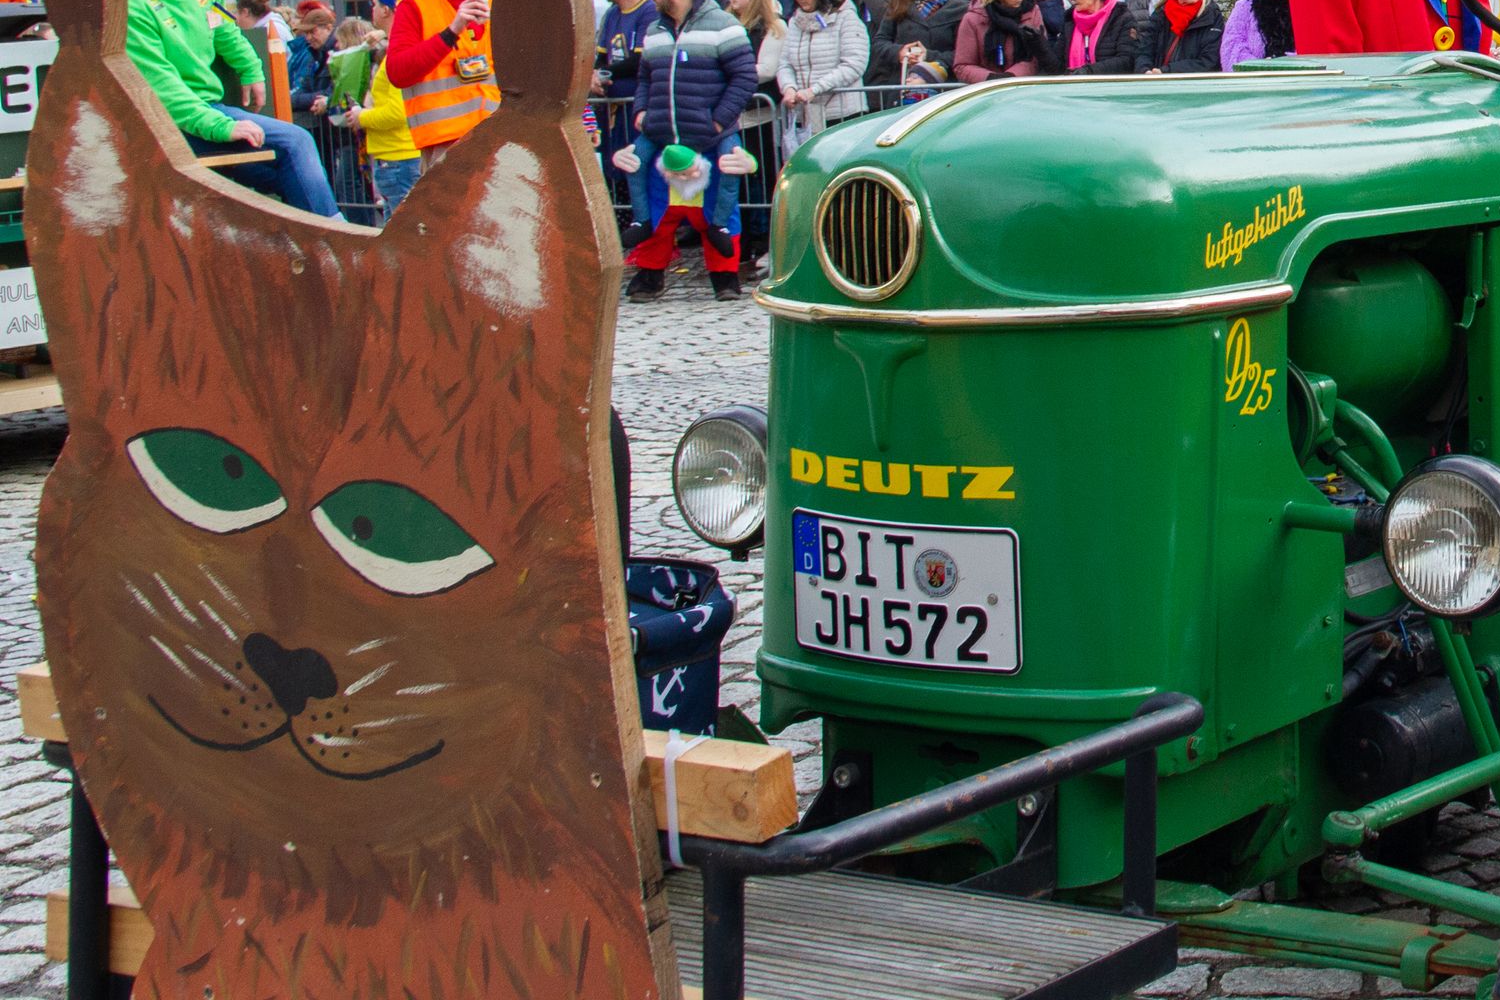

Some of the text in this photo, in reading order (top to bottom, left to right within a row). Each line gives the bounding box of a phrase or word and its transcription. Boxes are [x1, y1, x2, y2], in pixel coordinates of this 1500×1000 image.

[1205, 184, 1306, 269] luftgekühlt
[790, 447, 1016, 500] DEUTZ
[803, 552, 813, 571] D
[821, 525, 914, 590] BIT
[815, 590, 989, 663] JH 572
